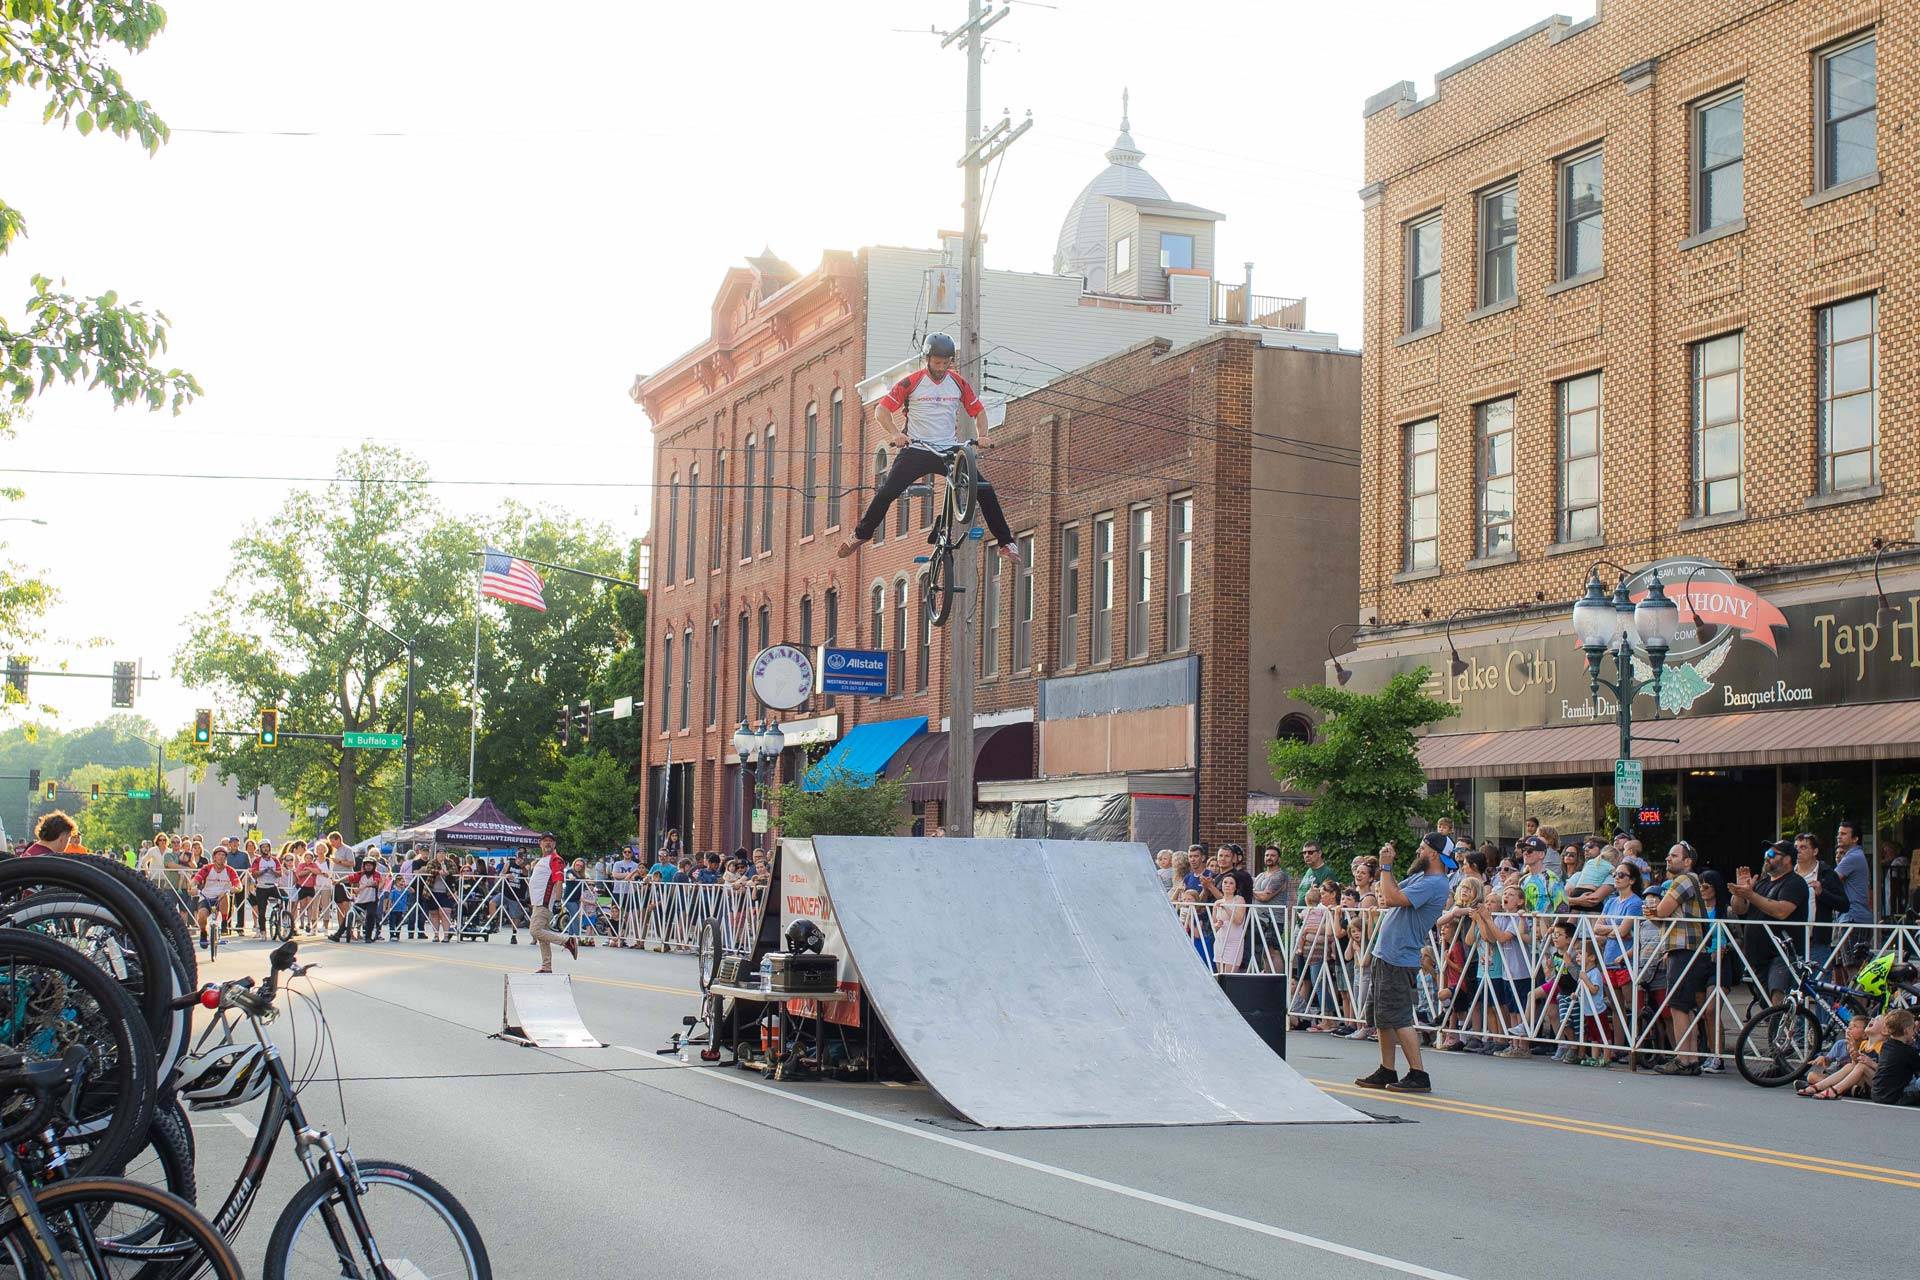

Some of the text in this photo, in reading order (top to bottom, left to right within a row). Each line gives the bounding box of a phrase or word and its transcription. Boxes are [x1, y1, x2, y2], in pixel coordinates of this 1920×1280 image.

[1672, 593, 1752, 619] NTHONY
[1674, 630, 1697, 641] COMP
[1813, 614, 1879, 681] Tap
[846, 658, 884, 670] Allstate
[1447, 649, 1557, 704] Lake City
[1723, 680, 1813, 709] Banquet Room
[1561, 699, 1596, 721] Family
[357, 736, 387, 745] Buffalo
[391, 738, 399, 746] St
[1616, 763, 1624, 775] 2
[1640, 811, 1660, 822] OPEN
